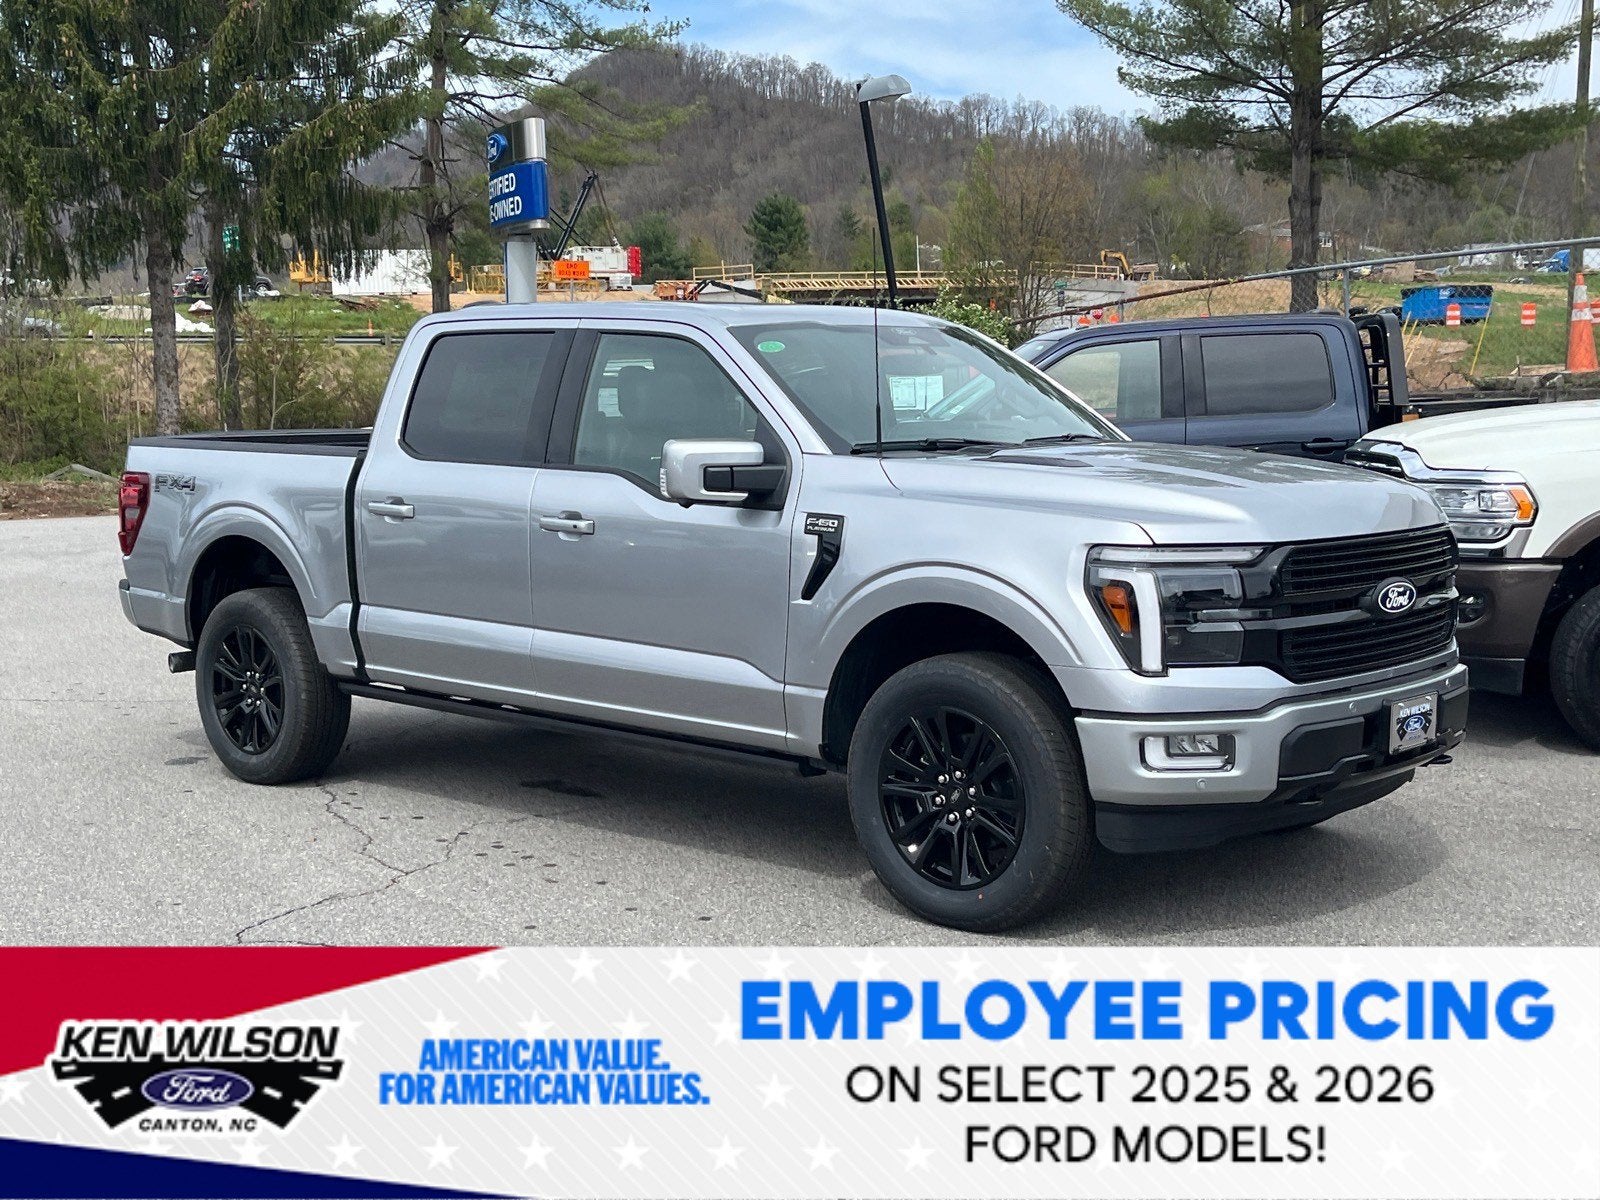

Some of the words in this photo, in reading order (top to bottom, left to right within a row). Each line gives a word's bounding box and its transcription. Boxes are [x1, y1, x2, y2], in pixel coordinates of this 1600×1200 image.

[154, 473, 196, 492] FX4
[807, 518, 838, 527] F-150
[1386, 586, 1410, 609] Ford
